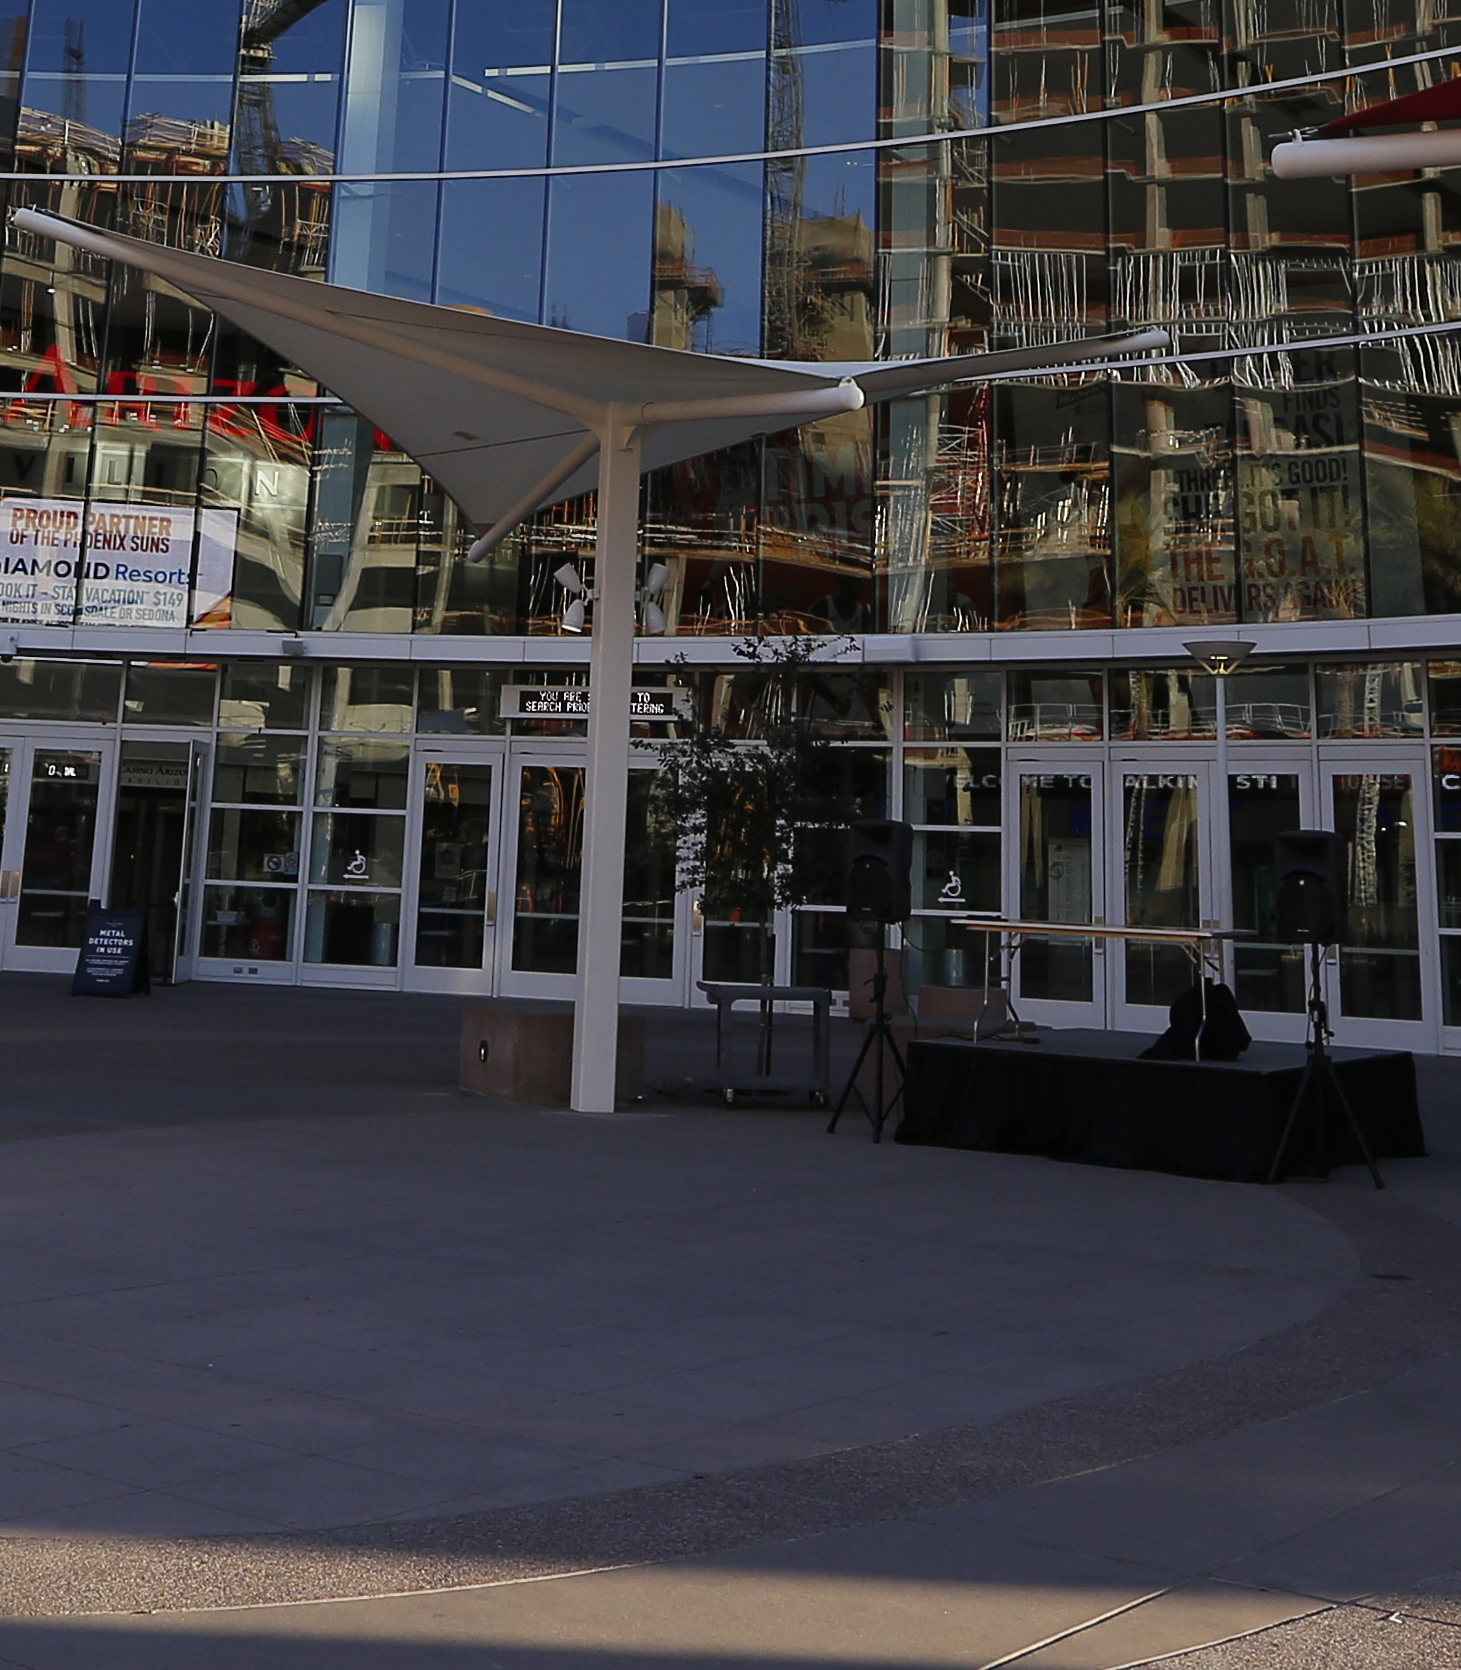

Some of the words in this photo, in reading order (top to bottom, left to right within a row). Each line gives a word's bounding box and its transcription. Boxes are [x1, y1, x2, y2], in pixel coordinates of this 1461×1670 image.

[8, 343, 392, 452] ARIZO
[1288, 457, 1349, 486] GOOD!
[12, 508, 79, 531] PROUD
[88, 513, 172, 537] PARTNER
[10, 529, 28, 545] OF
[33, 529, 59, 547] THE
[64, 531, 126, 551] PHOENIX
[130, 536, 170, 554] SUNS
[115, 564, 191, 586] Resorts
[26, 584, 38, 598] IT
[153, 591, 184, 608] $149
[1173, 581, 1276, 614] DELIVRS
[1, 601, 38, 614] NIGHTS
[40, 602, 51, 614] IN
[54, 604, 116, 619] SCOSDALE
[119, 607, 132, 620] OR
[135, 608, 176, 622] SEDONA
[539, 691, 558, 701] YOU
[564, 692, 582, 702] ARE
[637, 693, 651, 703] TO
[525, 701, 562, 712] SEARCH
[631, 703, 666, 715] TERING
[1125, 774, 1198, 789] ALKIN
[88, 937, 134, 947] DETECTORS
[100, 929, 126, 938] METAL
[96, 946, 105, 954] IN
[106, 947, 123, 955] USE
